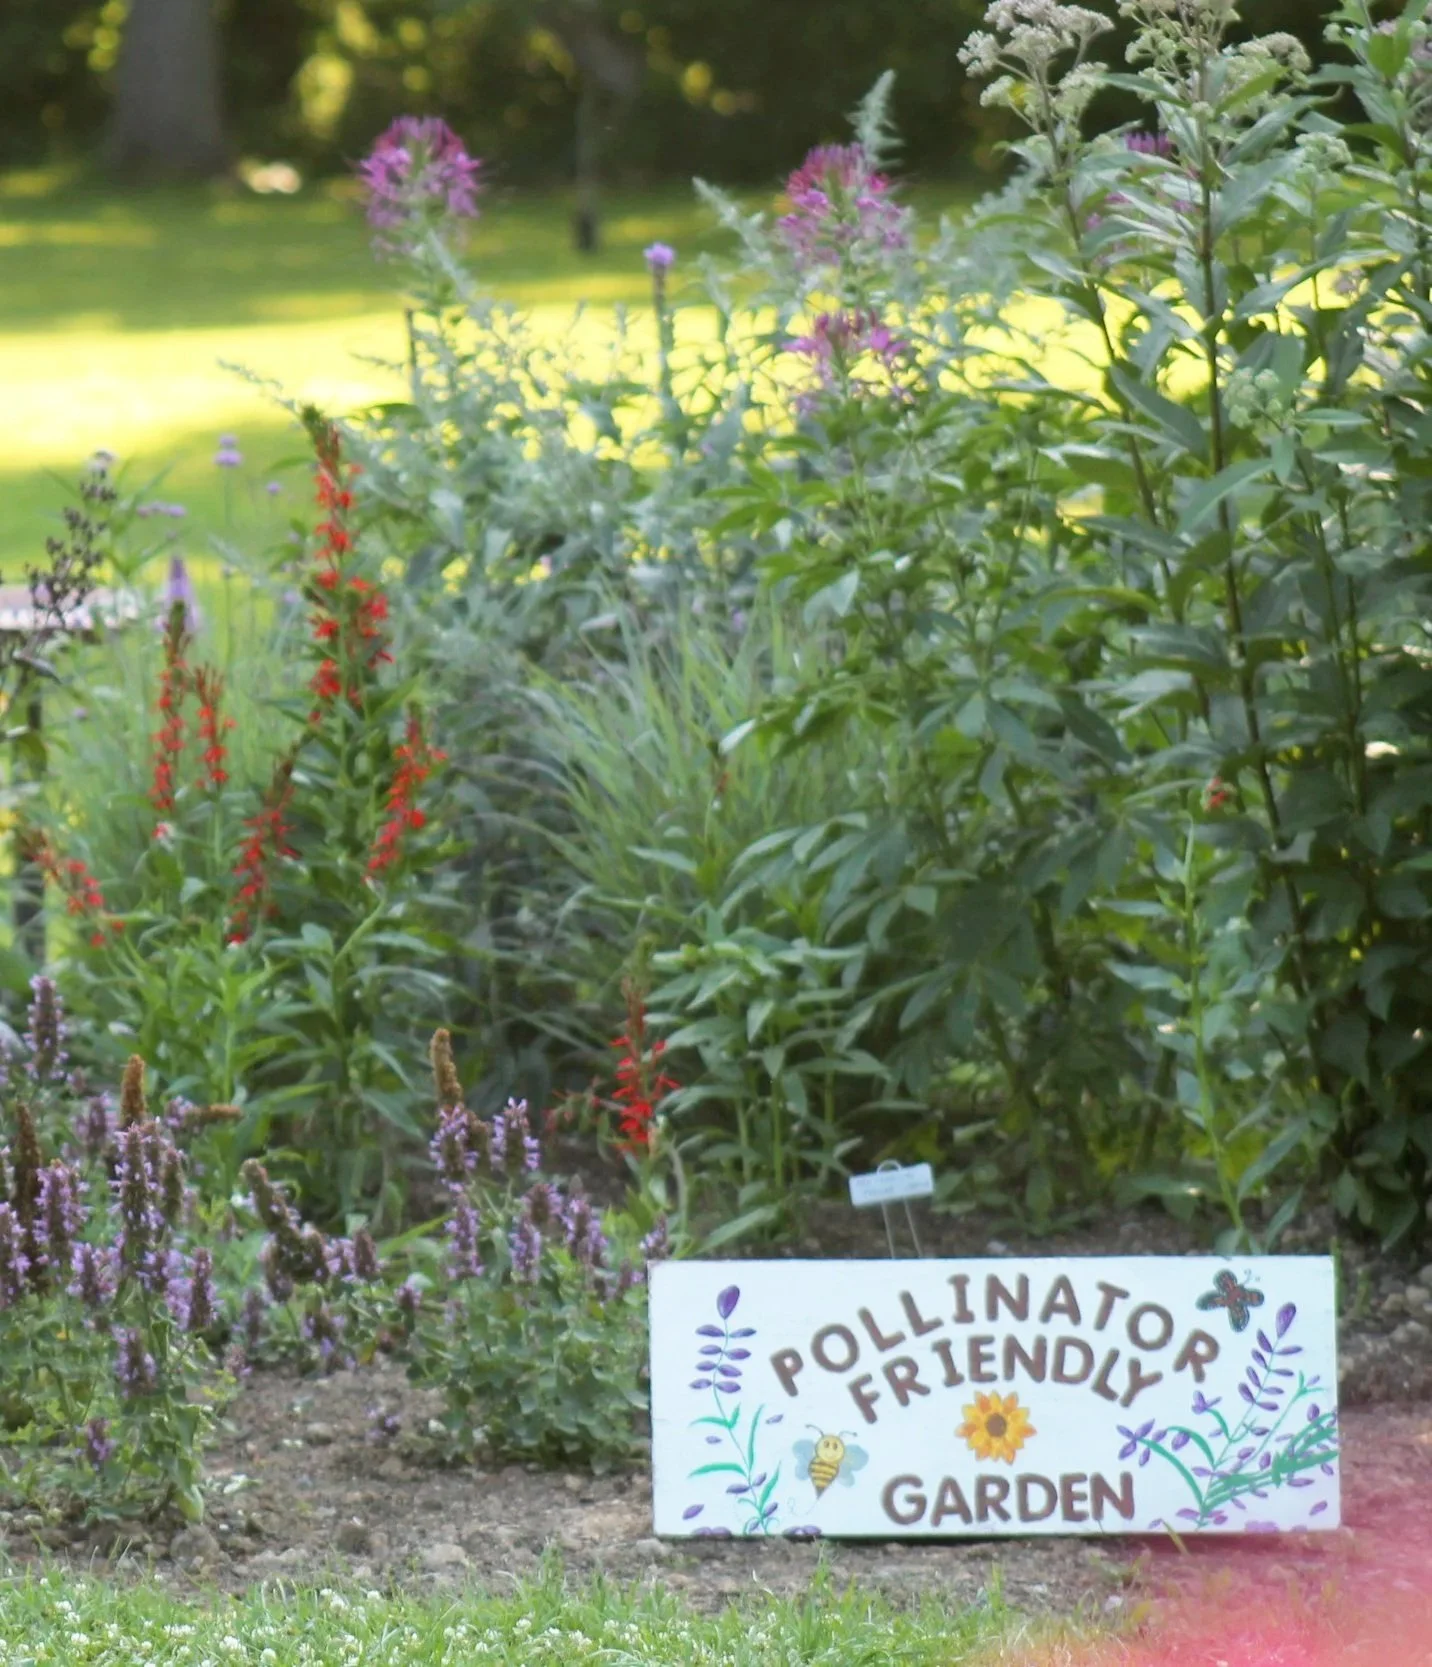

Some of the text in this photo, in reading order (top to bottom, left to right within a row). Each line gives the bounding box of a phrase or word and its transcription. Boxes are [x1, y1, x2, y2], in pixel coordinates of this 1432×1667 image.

[770, 1273, 1219, 1396] POLLINATOR
[848, 1335, 1163, 1424] FRIENDLY
[881, 1473, 1135, 1526] GARDEN
